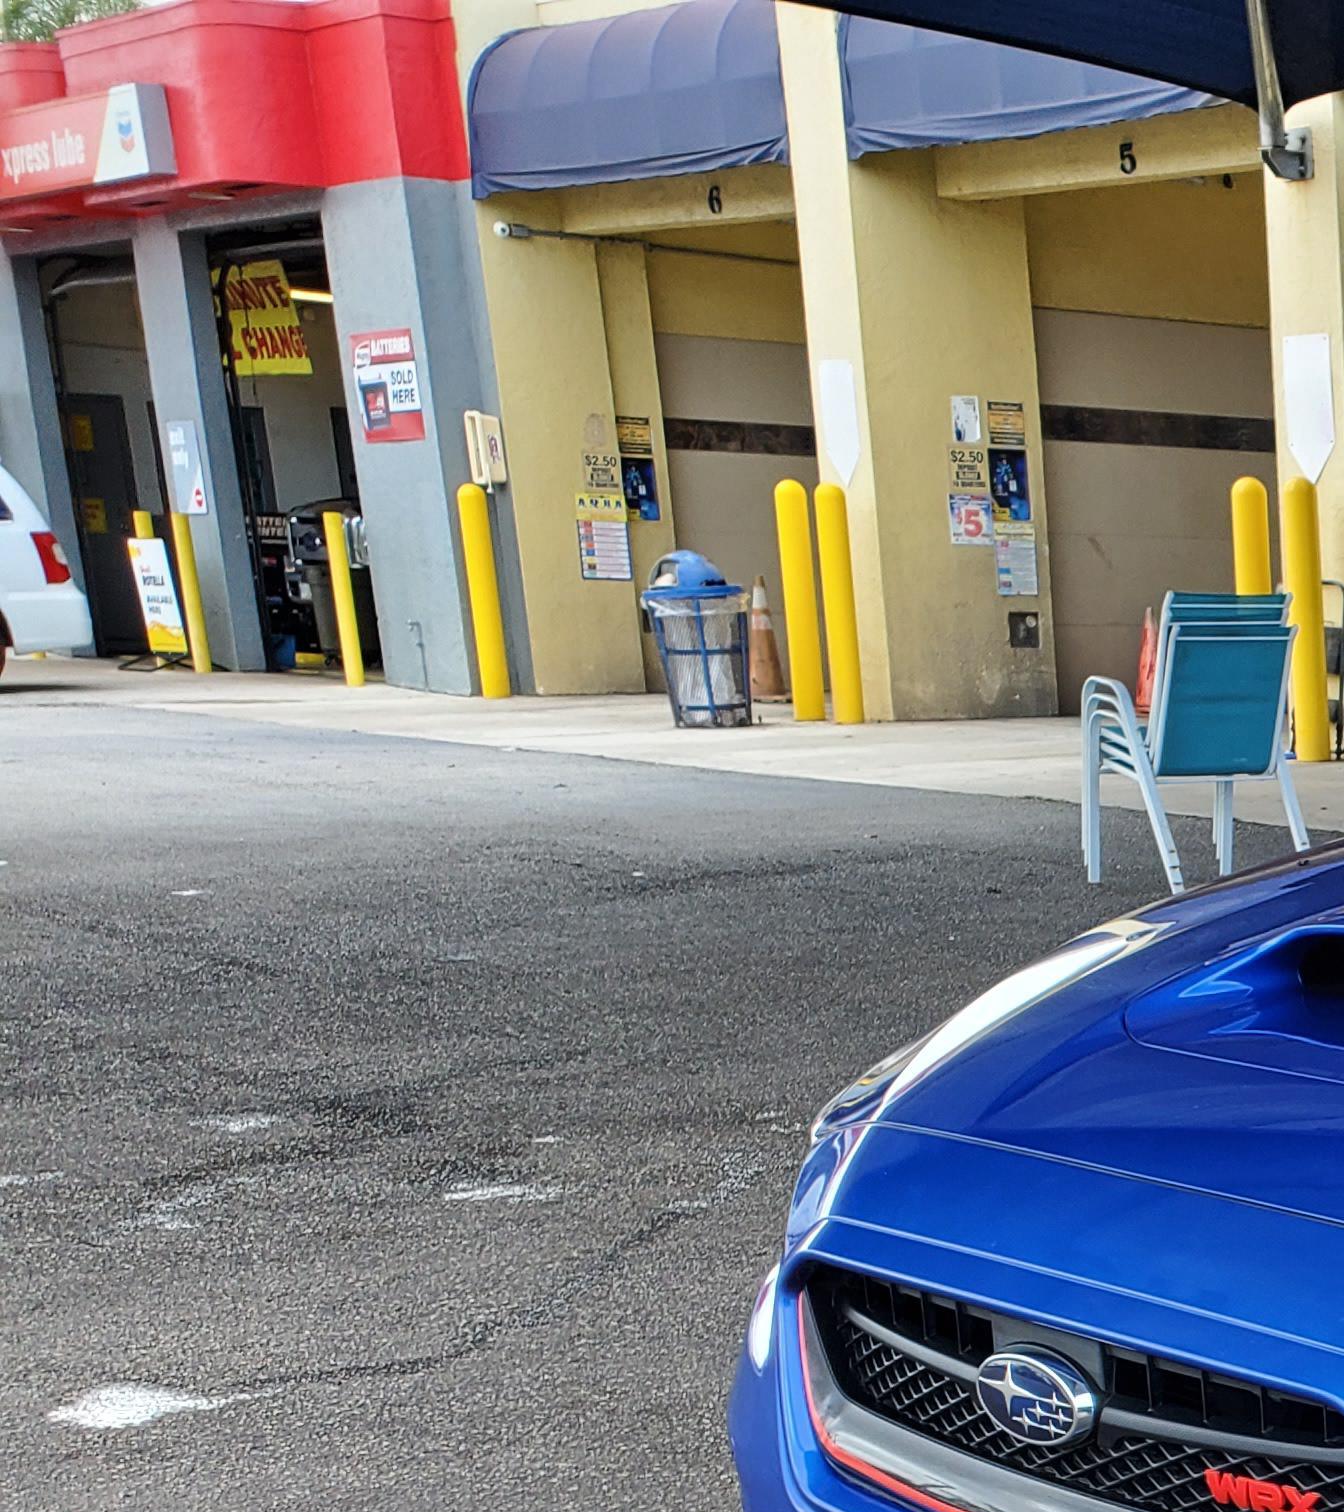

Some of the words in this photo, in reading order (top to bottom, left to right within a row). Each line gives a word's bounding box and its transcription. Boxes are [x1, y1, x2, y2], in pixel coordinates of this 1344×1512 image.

[51, 128, 86, 169] lube
[1119, 142, 1137, 174] 5
[708, 186, 722, 214] 6
[391, 369, 414, 385] SOLD
[392, 388, 416, 403] HERE
[585, 455, 617, 467] $2.50
[950, 450, 984, 463] $2.50
